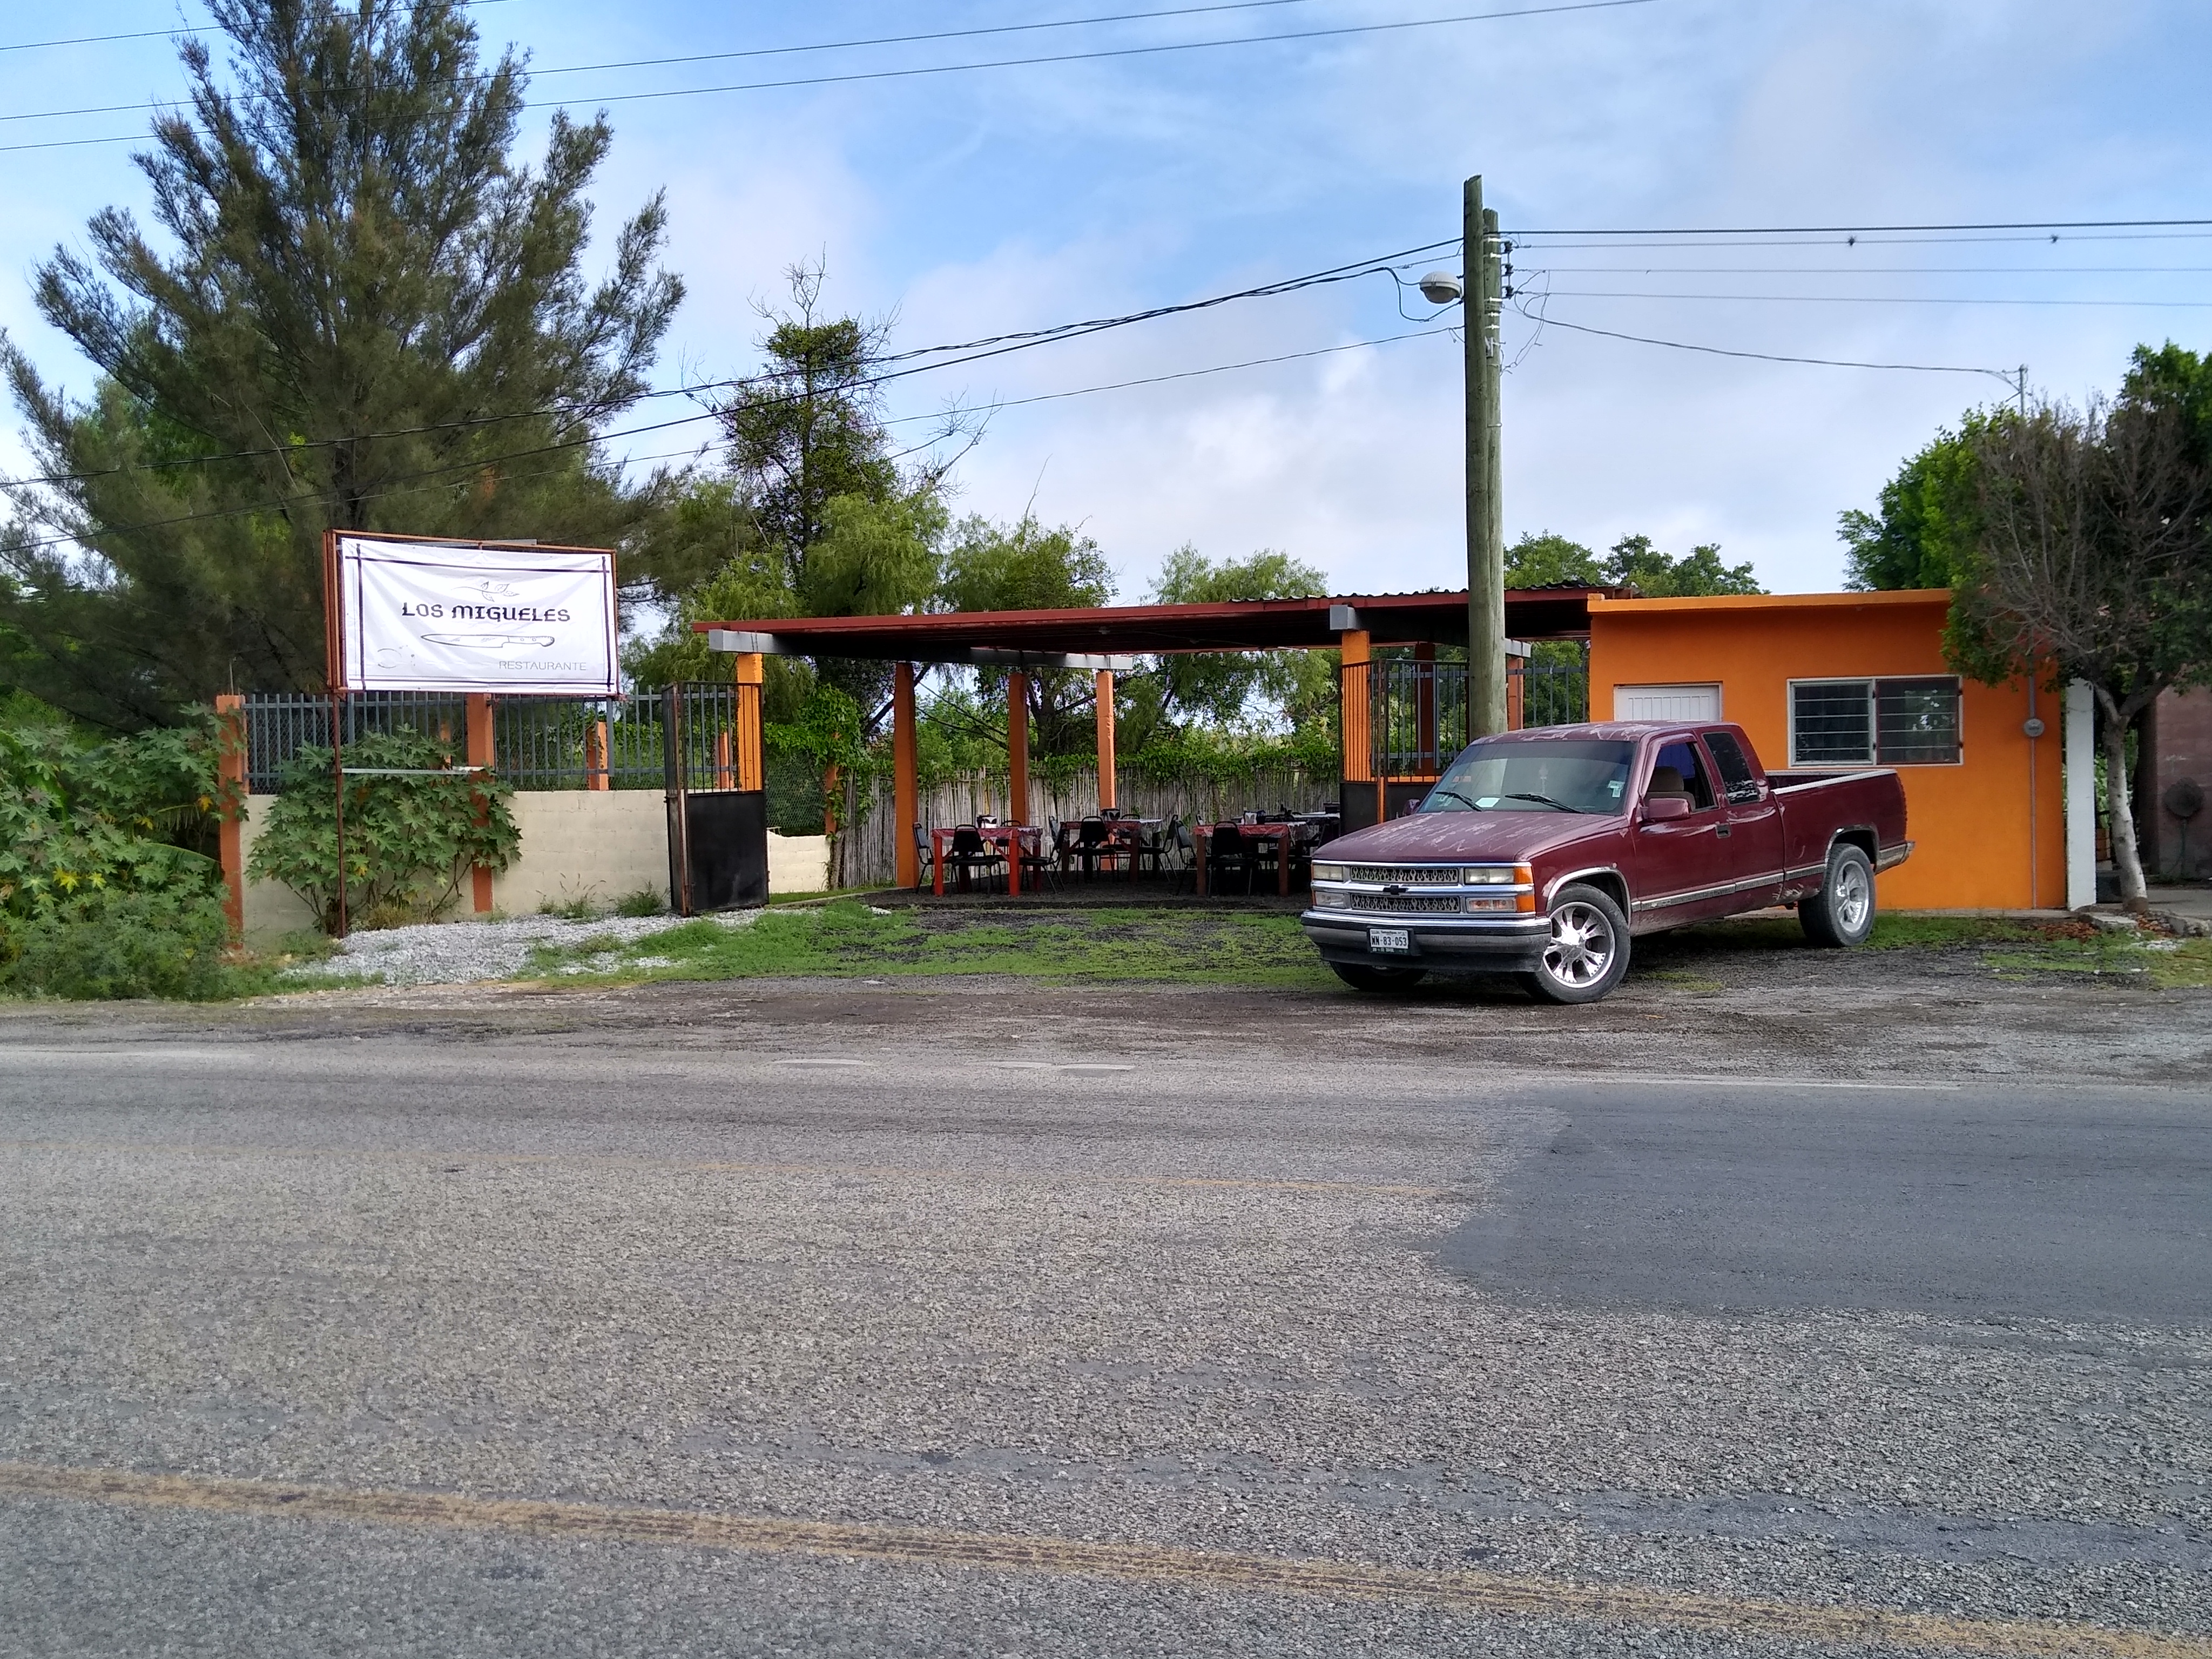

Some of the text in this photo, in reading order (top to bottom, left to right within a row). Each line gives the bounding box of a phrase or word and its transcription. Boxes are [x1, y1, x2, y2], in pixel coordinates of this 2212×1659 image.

[402, 602, 571, 622] LOS MIGUELES
[499, 660, 587, 671] RESTAURANTE
